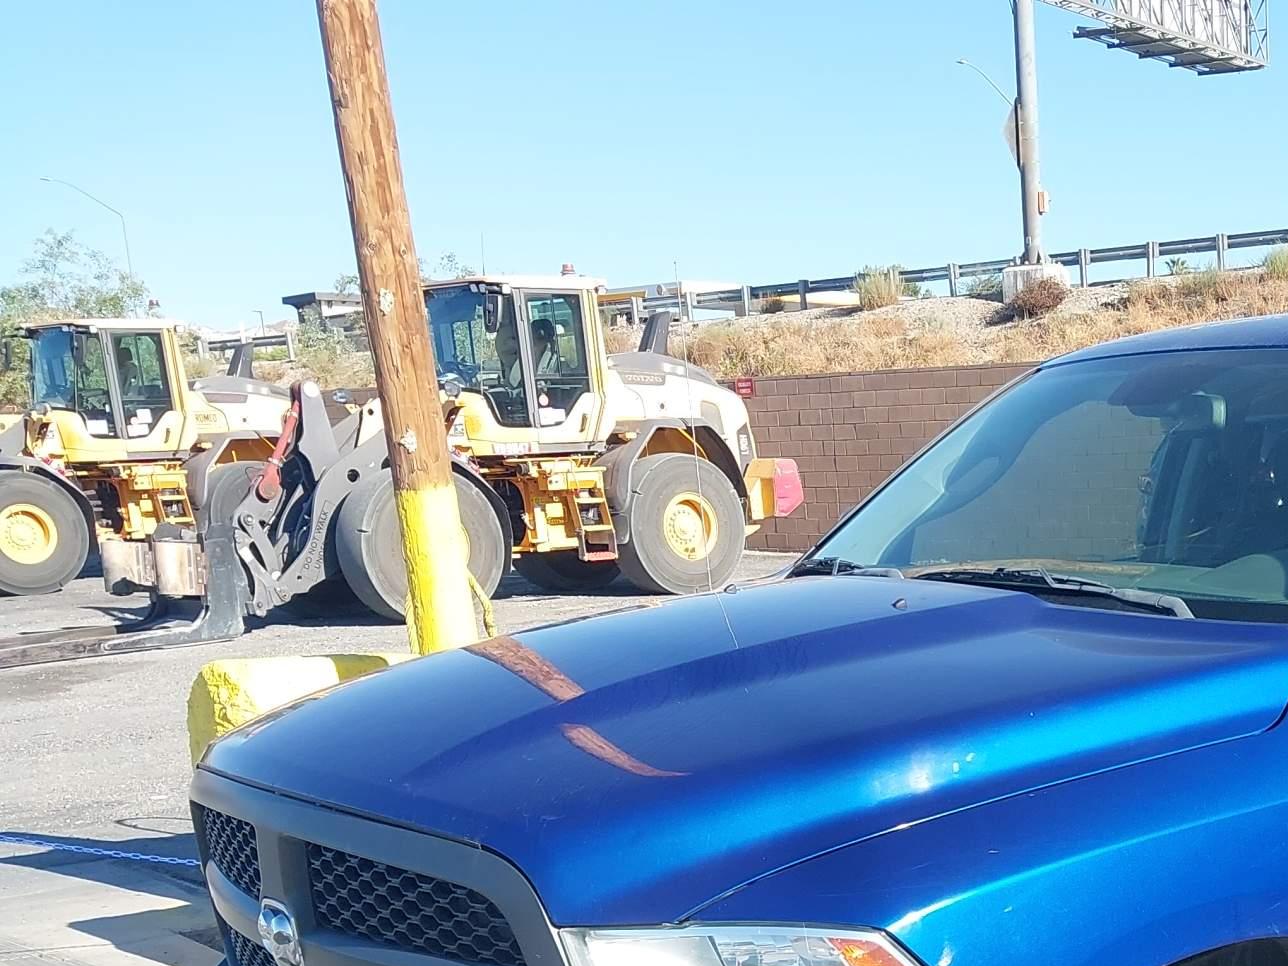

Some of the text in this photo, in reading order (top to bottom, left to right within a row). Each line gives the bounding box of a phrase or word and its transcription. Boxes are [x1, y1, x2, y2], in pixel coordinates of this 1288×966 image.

[304, 511, 328, 569] DO NOT WALK
